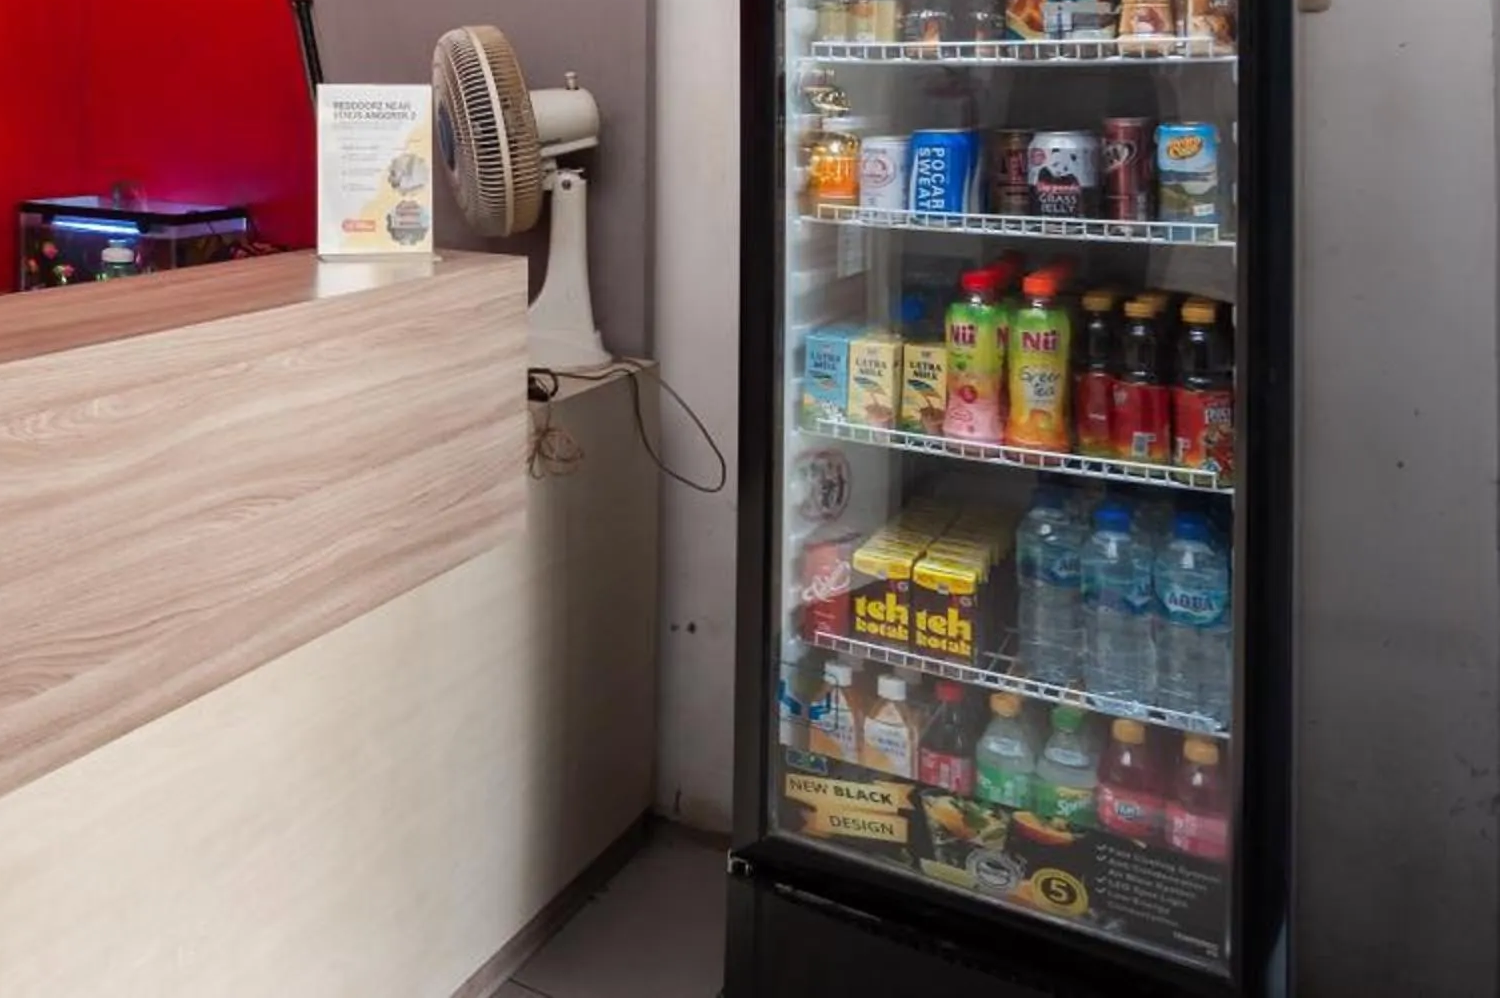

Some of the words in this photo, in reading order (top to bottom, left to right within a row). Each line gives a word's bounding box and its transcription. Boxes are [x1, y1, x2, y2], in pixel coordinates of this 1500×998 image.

[917, 147, 932, 210] SWEAT
[931, 147, 946, 210] POCAR
[1038, 193, 1077, 204] GRASS
[854, 591, 909, 625] teh
[915, 607, 972, 641] teh
[789, 778, 828, 795] NEW
[833, 785, 893, 806] BLACK
[828, 814, 894, 836] DESIGN
[1049, 878, 1070, 902] 5
